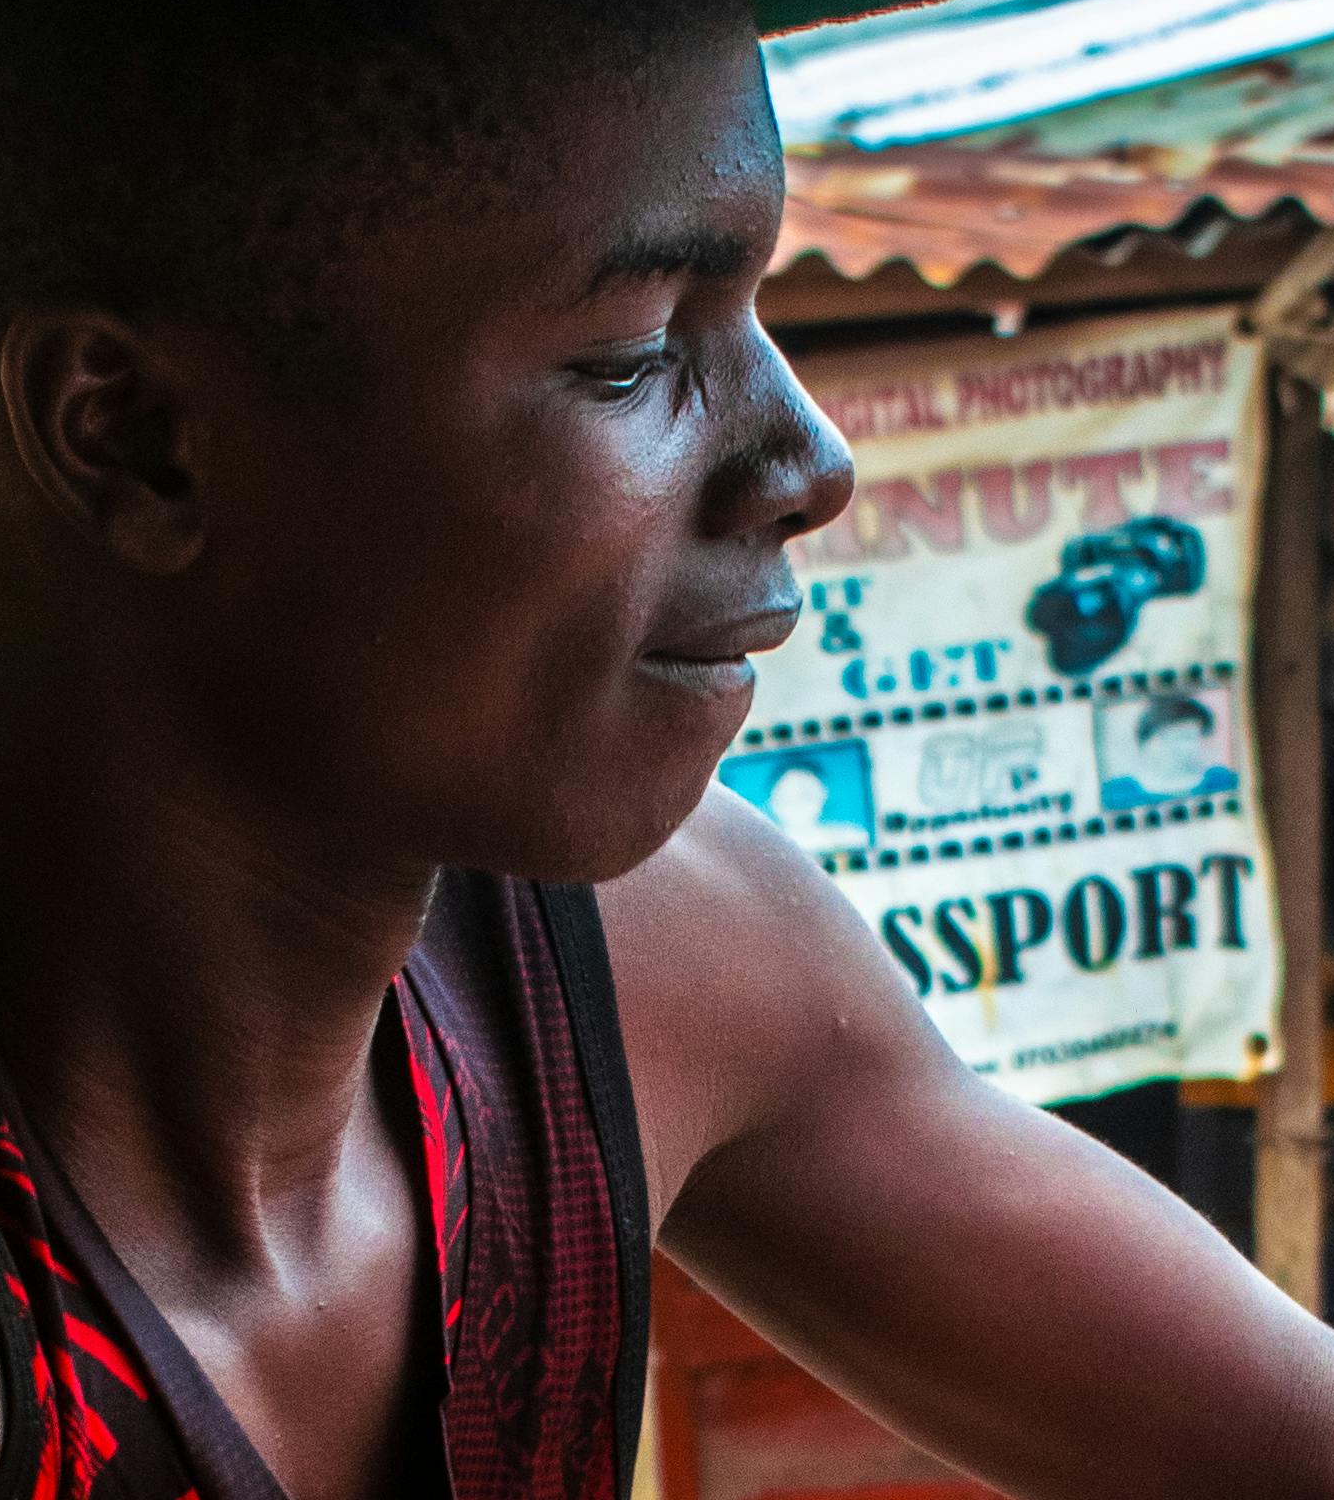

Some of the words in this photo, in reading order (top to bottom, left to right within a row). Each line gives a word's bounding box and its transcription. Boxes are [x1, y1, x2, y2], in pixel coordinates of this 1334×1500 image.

[954, 342, 1227, 425] PHOTOGRAPHY
[789, 438, 1235, 566] INUTE
[841, 638, 1011, 700] GET
[879, 851, 1255, 997] SSPORT
